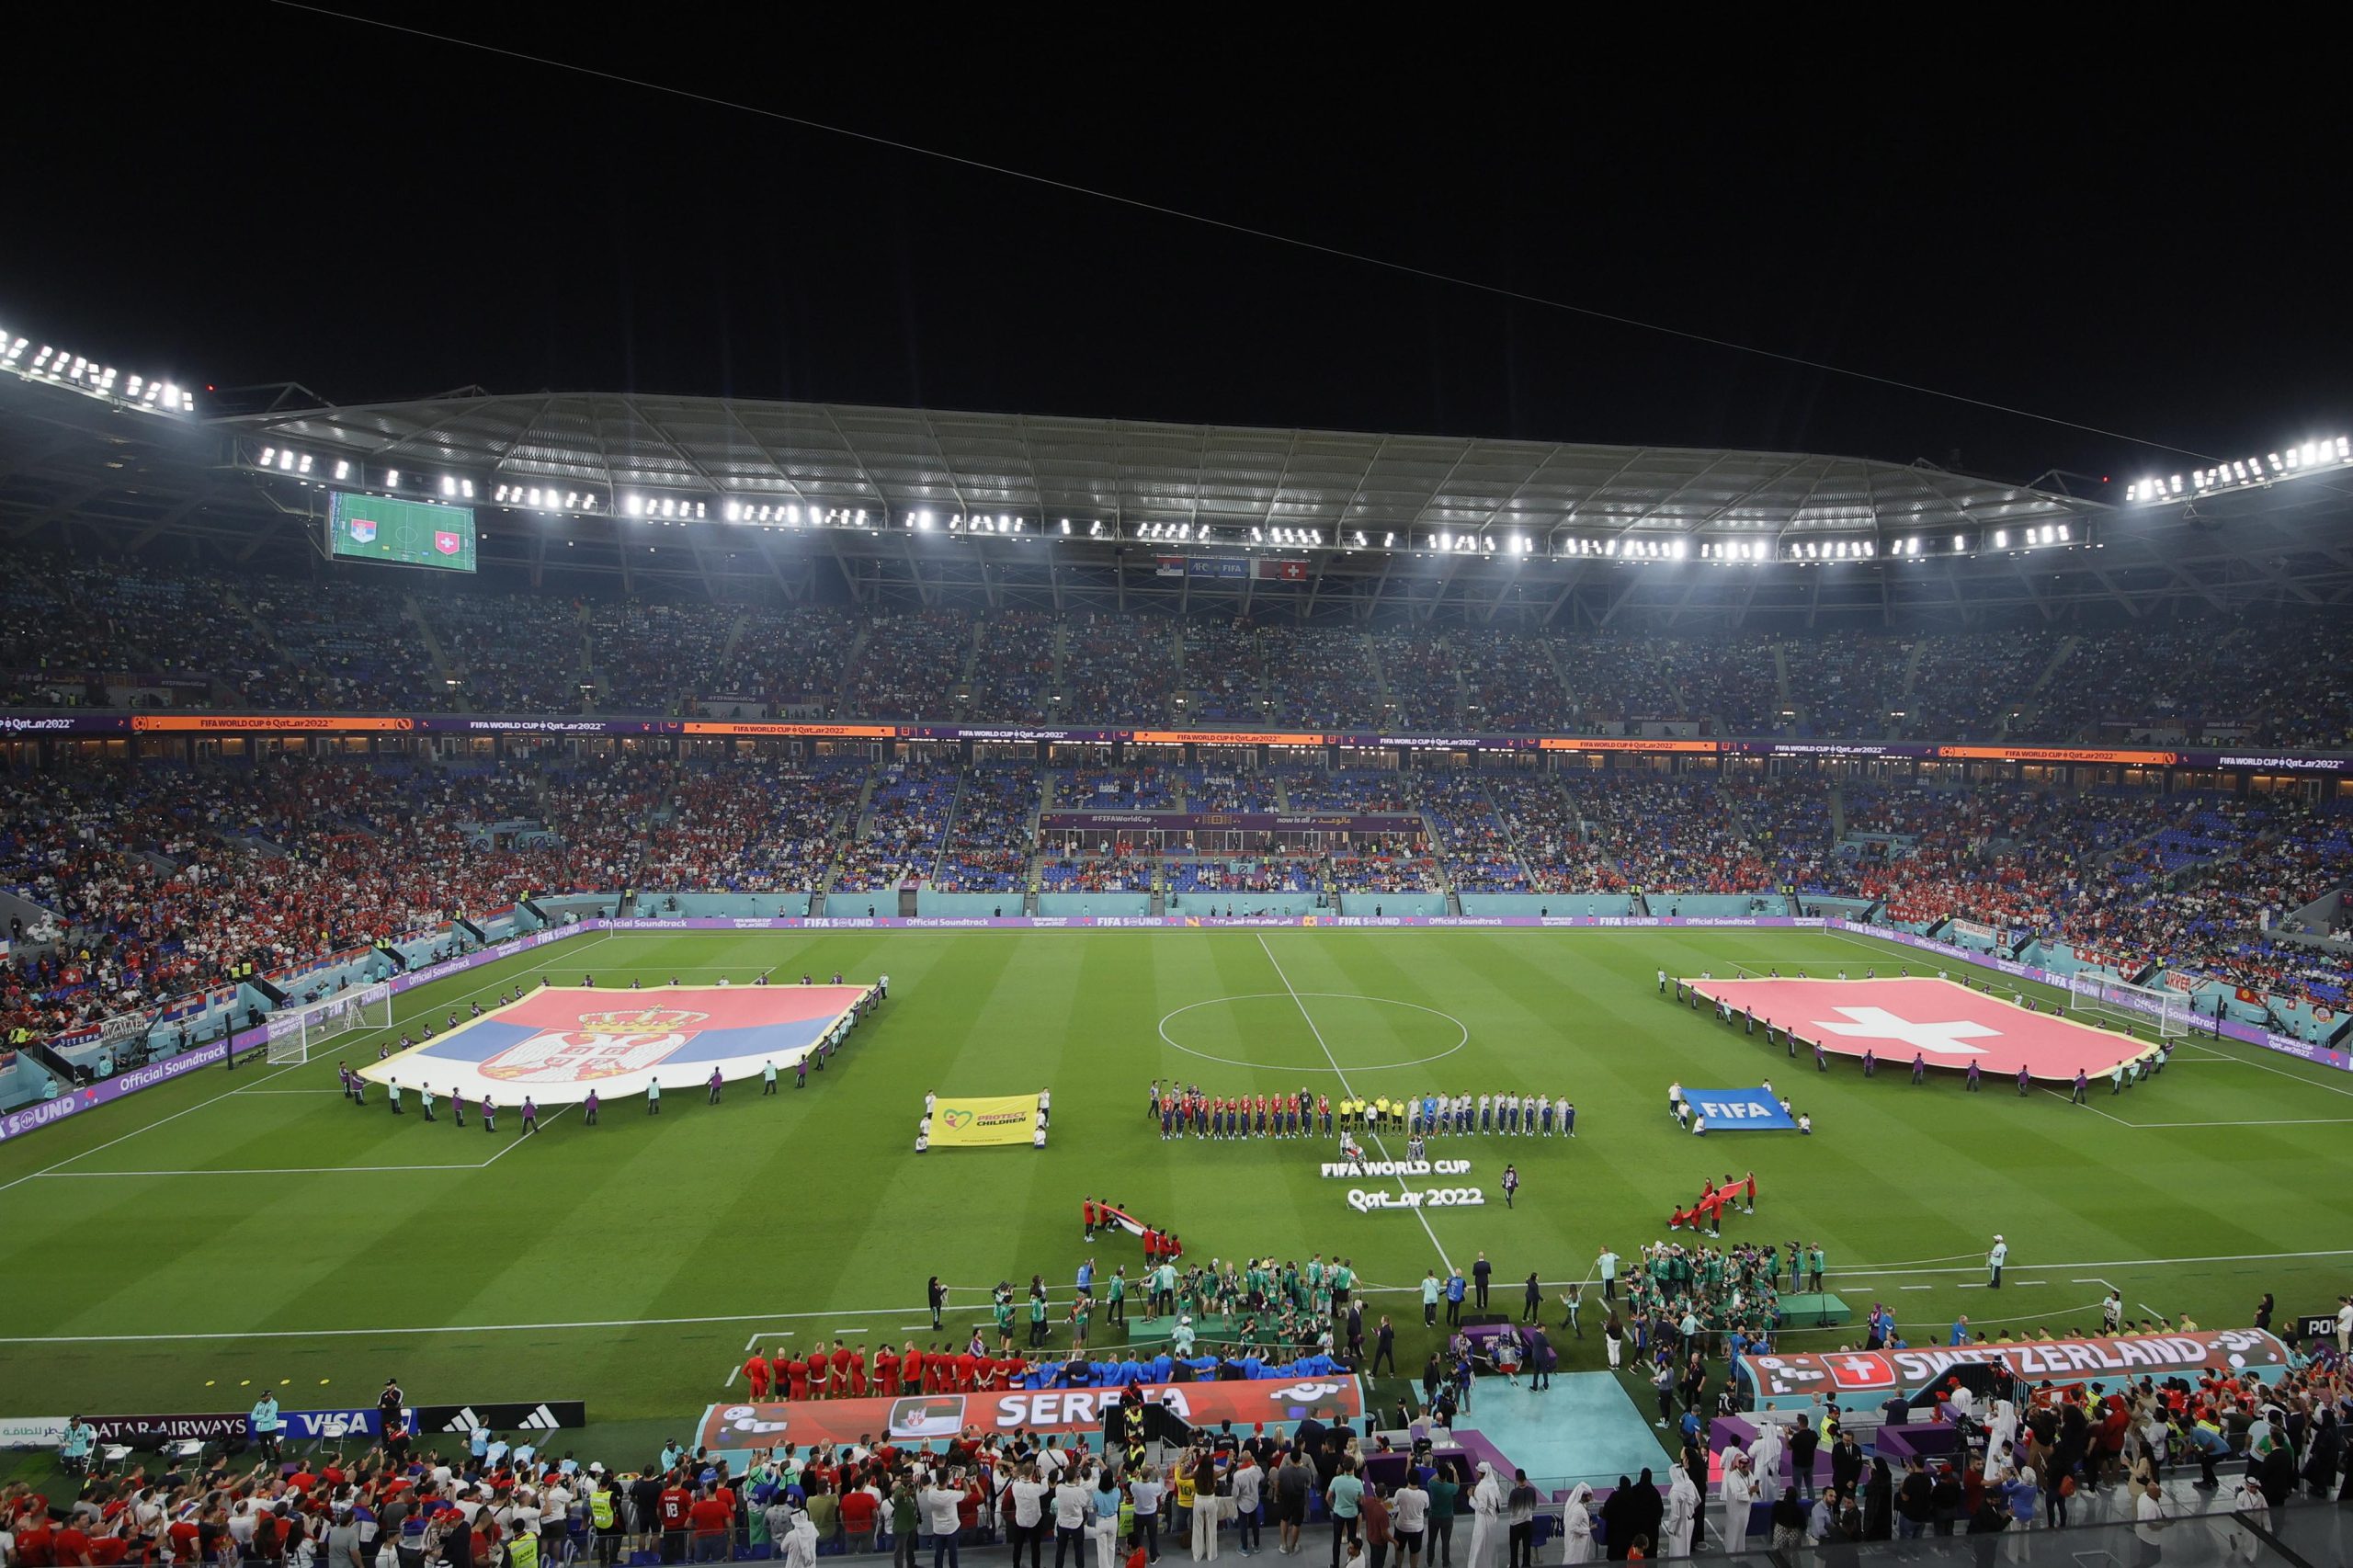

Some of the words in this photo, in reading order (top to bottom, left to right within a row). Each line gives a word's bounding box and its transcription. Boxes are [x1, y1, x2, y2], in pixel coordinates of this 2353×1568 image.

[804, 918, 830, 927] FIFA
[1097, 918, 1121, 926] FIFA
[1846, 921, 1864, 933] FIFA
[1953, 920, 1964, 929] BAD
[538, 931, 554, 944] FIFA
[1914, 938, 1934, 950] Official
[1935, 942, 1970, 958] Soundtrack
[409, 971, 432, 986] Official
[433, 958, 470, 978] Soundtrack
[2046, 973, 2068, 988] FIFA
[2134, 998, 2165, 1014] Officia
[120, 1067, 164, 1091] Official
[165, 1044, 226, 1076] Soundtrack
[9, 1096, 75, 1134] SOUND
[977, 1111, 1027, 1121] PROTECT
[1700, 1102, 1772, 1118] FIFA
[976, 1117, 1026, 1126] CHILDREN
[1321, 1161, 1362, 1177] FIFA
[1363, 1160, 1431, 1177] WORLD
[1434, 1160, 1471, 1175] CUP
[1347, 1188, 1425, 1213] Qatar
[1426, 1187, 1485, 1206] 2022
[1483, 1335, 1499, 1343] now
[997, 1387, 1191, 1426] SERA
[159, 1419, 247, 1437] AIRWAYS
[297, 1412, 369, 1435] VISA
[3, 1426, 42, 1437] للطاقة
[666, 1503, 678, 1517] 18
